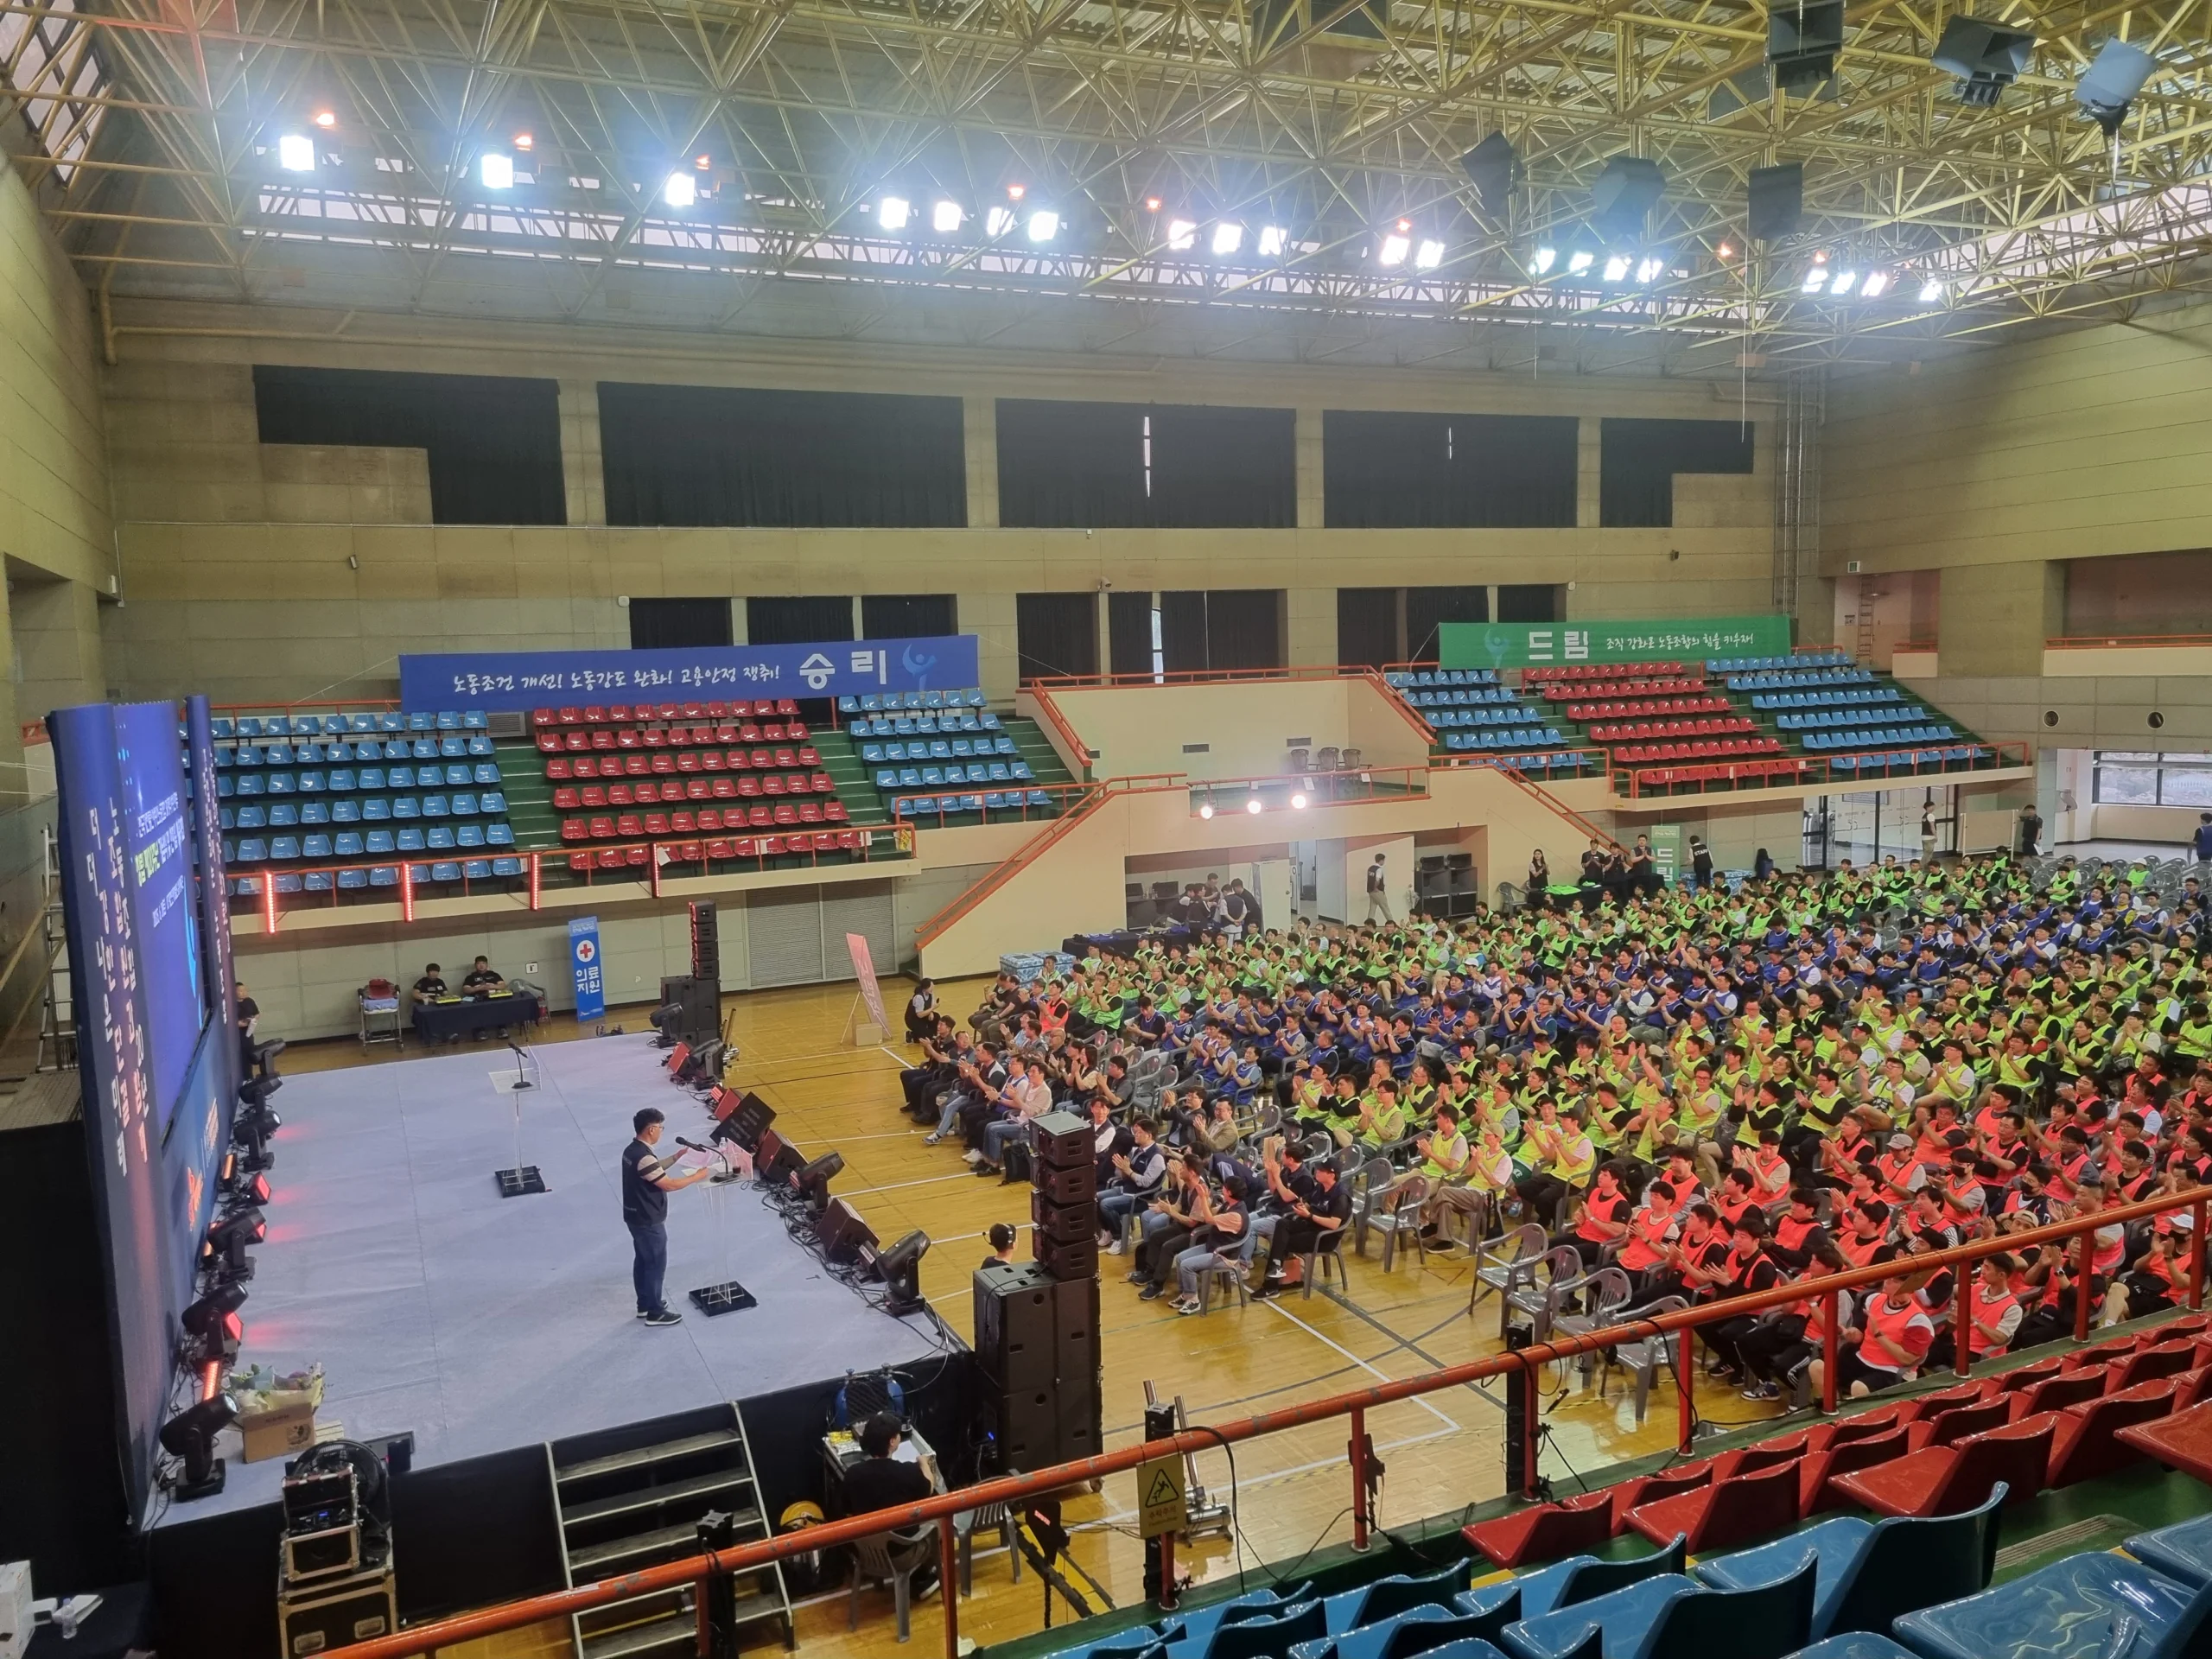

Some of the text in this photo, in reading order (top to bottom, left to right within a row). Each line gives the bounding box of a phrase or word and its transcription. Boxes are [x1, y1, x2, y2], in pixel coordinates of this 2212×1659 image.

[1529, 631, 1589, 660] 드림
[1606, 637, 1624, 652] 조직
[1627, 636, 1655, 650] 강화로
[1658, 634, 1700, 651] 노동조합의
[1702, 632, 1720, 650] 힘을
[454, 662, 780, 695] 노동조건 개선! 노동강도 완화! 고용안정 쟁취!
[799, 650, 887, 690] 승리
[576, 966, 599, 982] 의료
[577, 979, 601, 995] 지원
